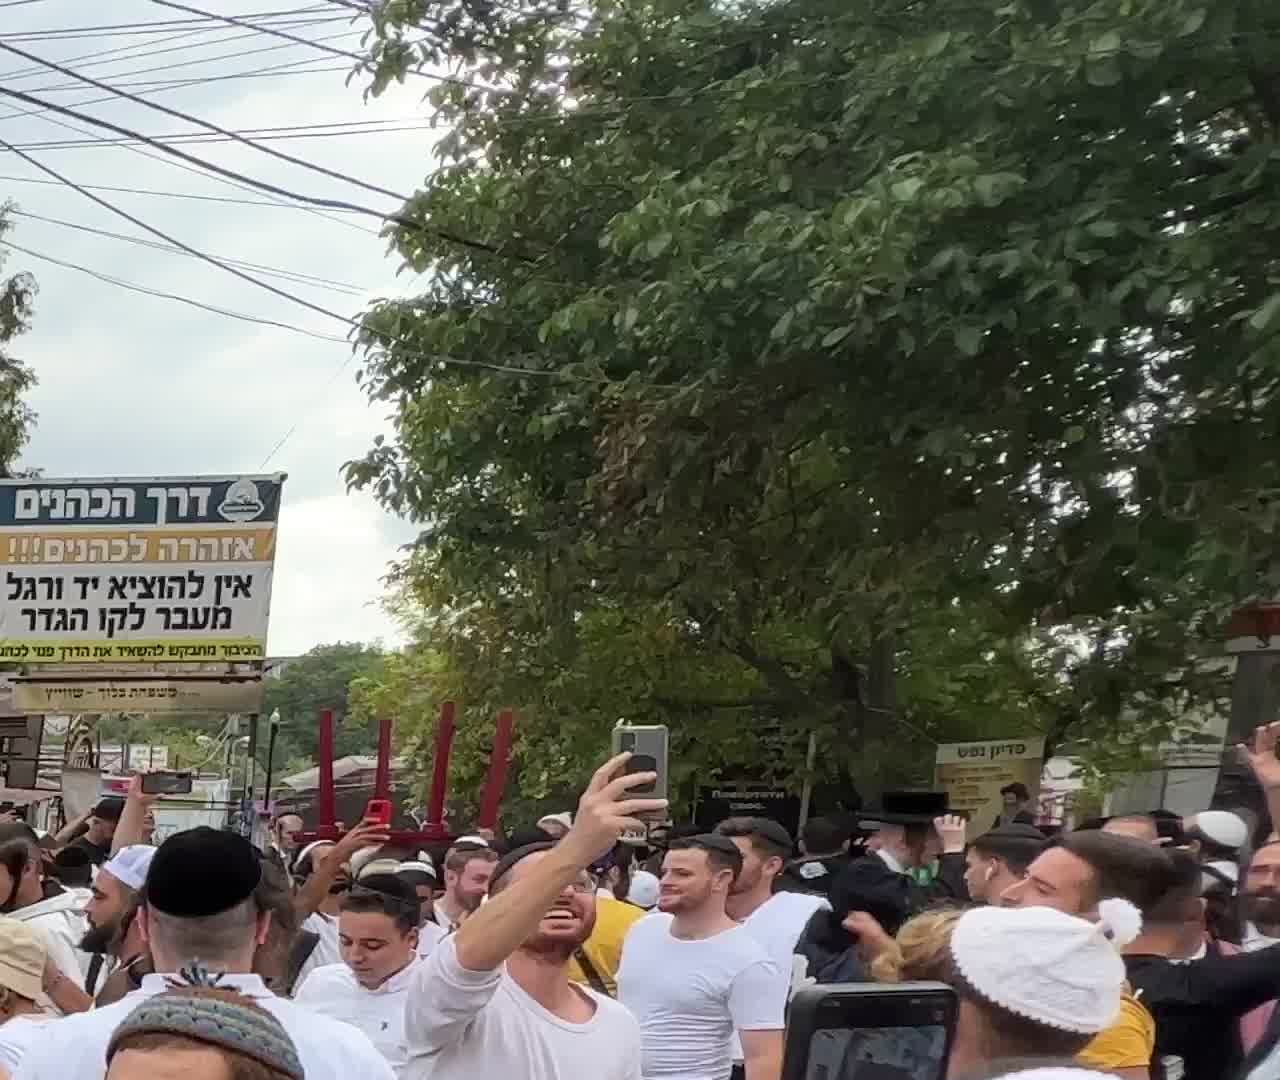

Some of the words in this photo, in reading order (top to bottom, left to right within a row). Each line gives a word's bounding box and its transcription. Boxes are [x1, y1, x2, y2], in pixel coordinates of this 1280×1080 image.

[14, 487, 136, 520] הכהנים
[146, 487, 212, 526] דרך
[7, 532, 149, 563] לכהנים!!!
[157, 536, 256, 561] אזהרה
[6, 571, 64, 601] ורגל
[73, 575, 99, 600] יד
[107, 570, 204, 600] להוציא
[214, 574, 253, 605] אין
[21, 607, 89, 632] הגדר
[98, 602, 146, 639] לקו
[155, 605, 233, 630] מעבר
[58, 646, 90, 661] הדרך
[93, 646, 113, 657] את
